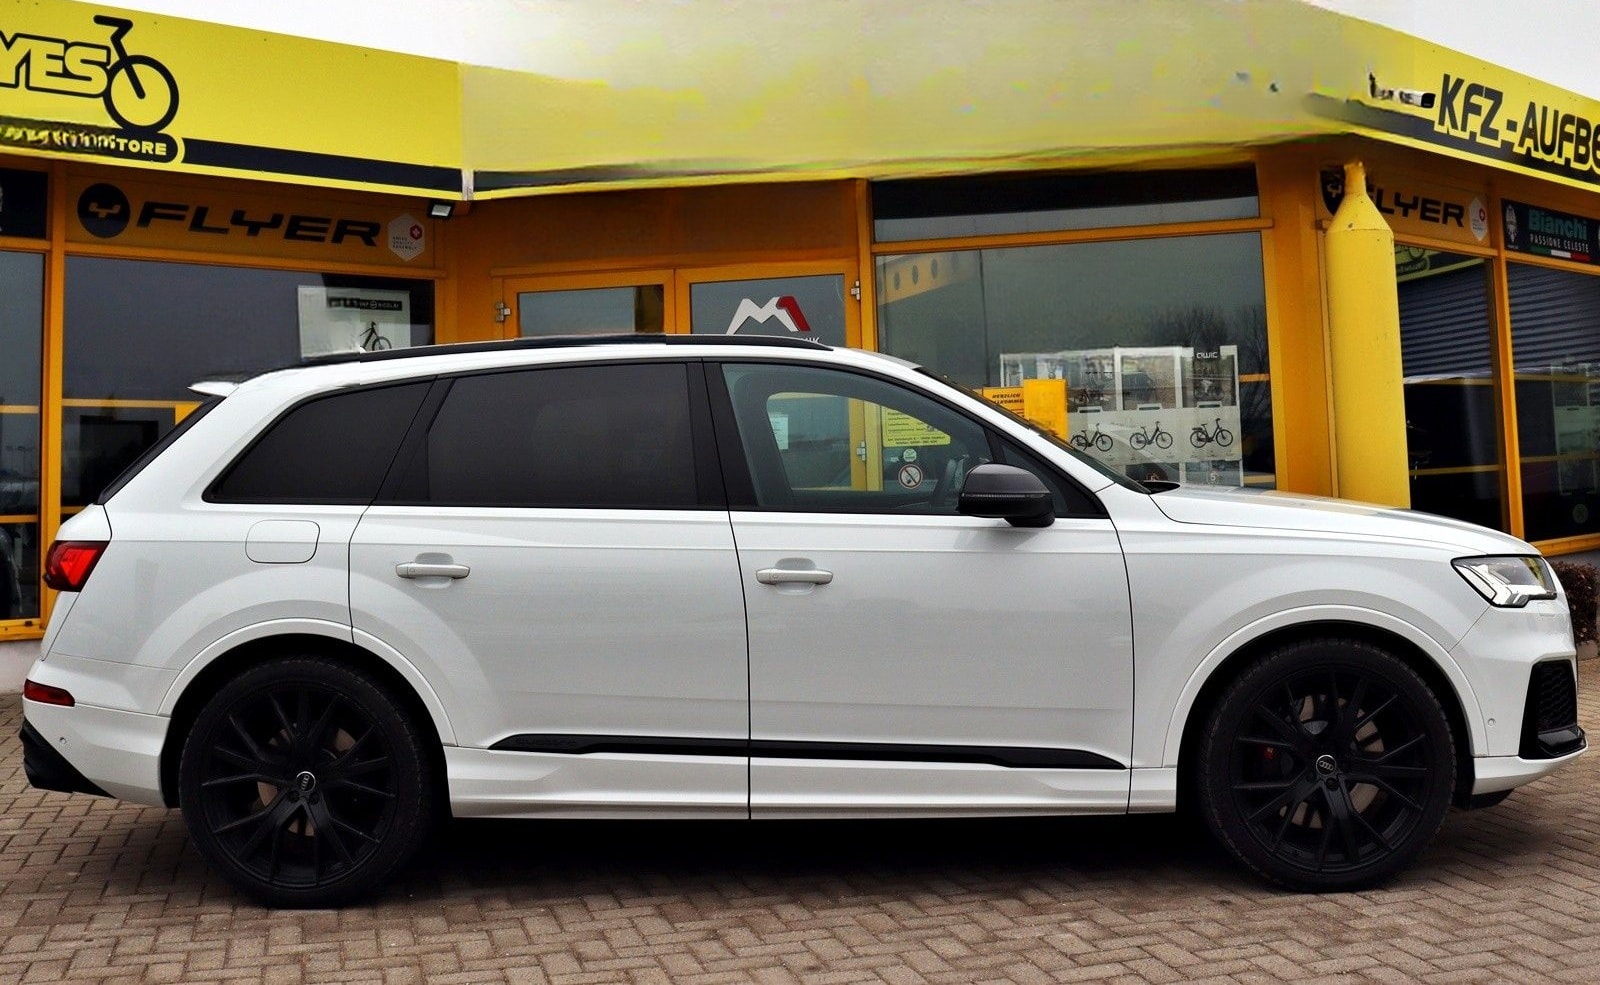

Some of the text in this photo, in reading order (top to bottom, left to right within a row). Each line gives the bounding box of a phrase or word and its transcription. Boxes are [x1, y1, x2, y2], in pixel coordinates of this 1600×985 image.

[136, 201, 381, 247] FLYER
[1528, 208, 1588, 241] Bianchi
[1529, 233, 1561, 248] PASSIONE
[1563, 240, 1589, 254] CELESTE
